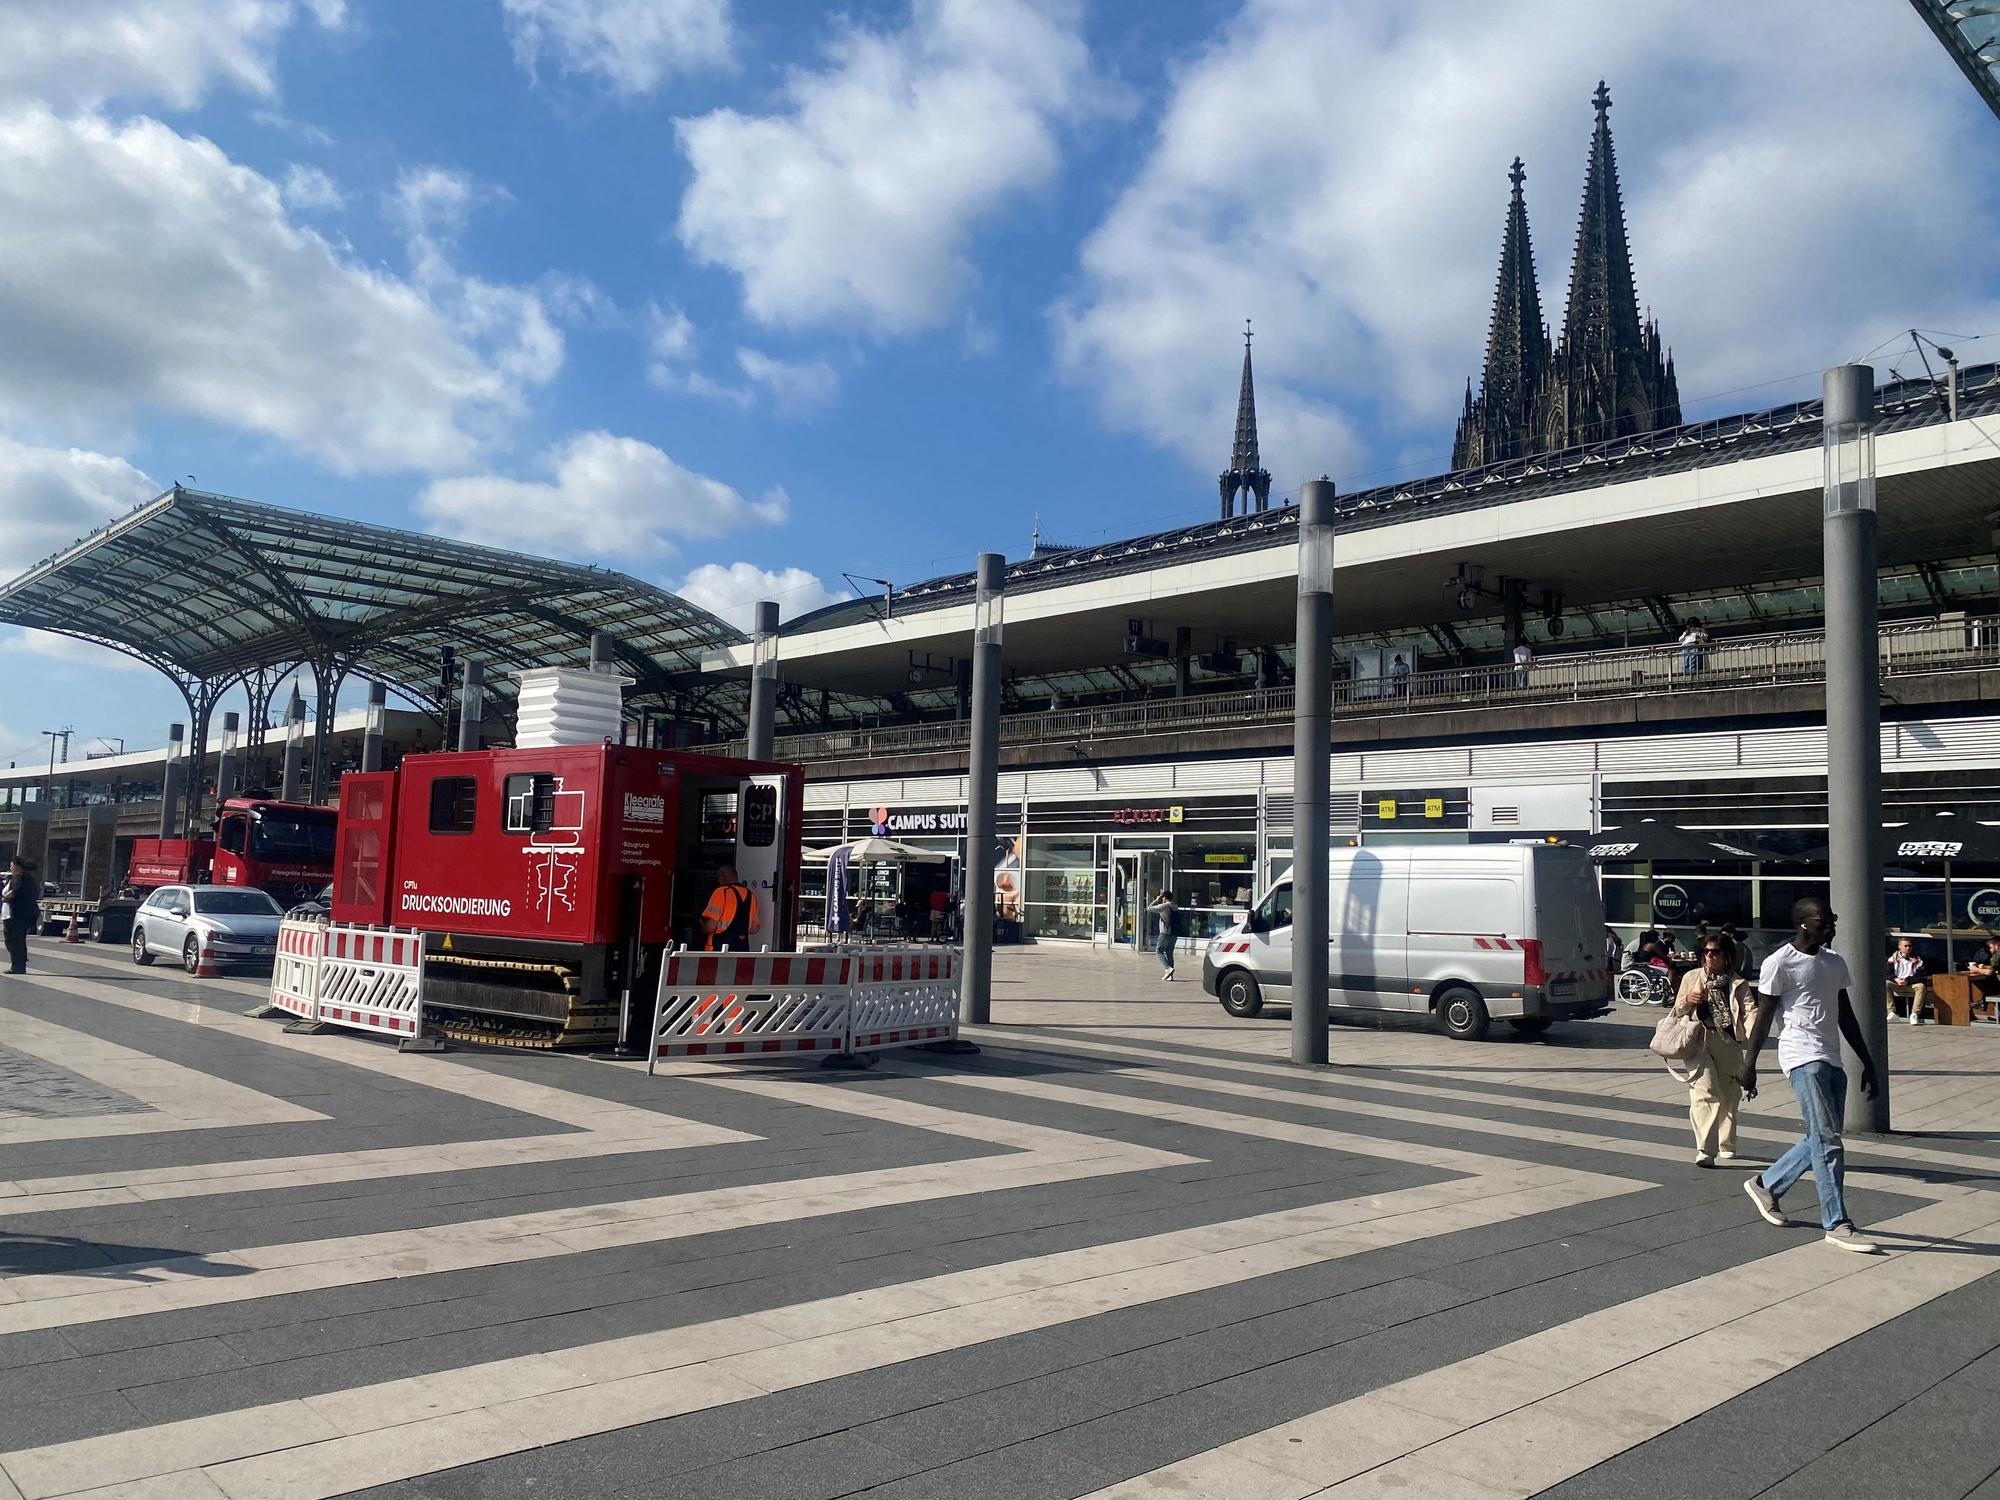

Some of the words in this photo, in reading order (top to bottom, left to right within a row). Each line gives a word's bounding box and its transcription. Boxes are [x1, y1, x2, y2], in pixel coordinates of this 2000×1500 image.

[887, 814, 936, 831] CAMPUS
[940, 813, 968, 829] SUIT
[1899, 842, 1963, 851] back
[401, 893, 511, 917] DRUCKSONDIERUNG
[1658, 899, 1682, 907] VIELFALT
